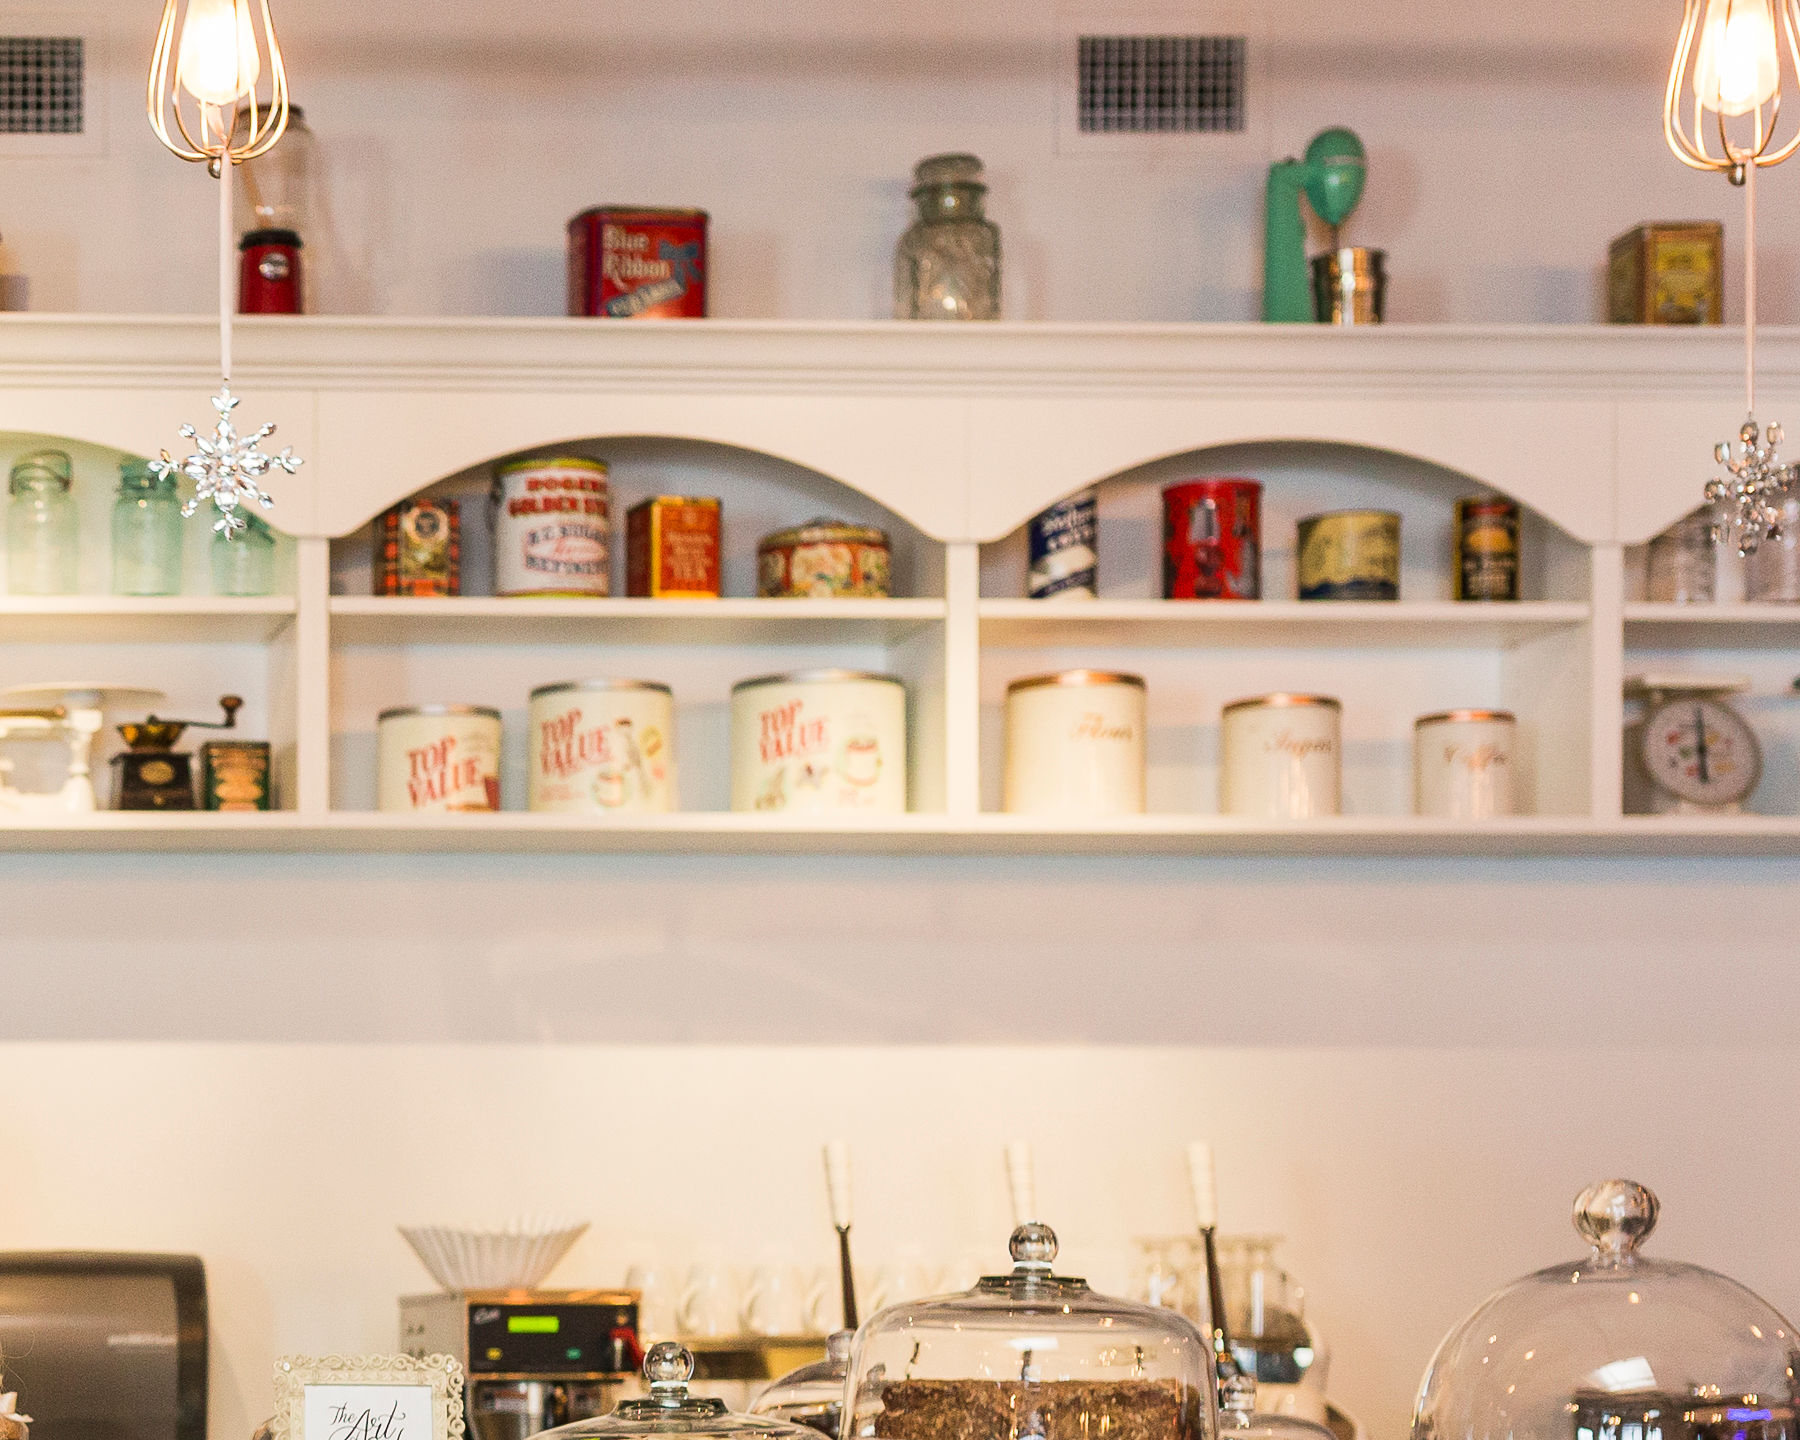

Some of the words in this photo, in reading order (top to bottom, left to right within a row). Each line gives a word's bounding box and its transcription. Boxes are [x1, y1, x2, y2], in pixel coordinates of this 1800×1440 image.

[541, 708, 583, 750] TOP
[760, 698, 804, 736] TOP
[407, 735, 457, 779] TOP
[541, 726, 612, 776] VALUE
[760, 715, 830, 764] VALUE
[407, 757, 480, 809] VALUE
[328, 1401, 357, 1425] The
